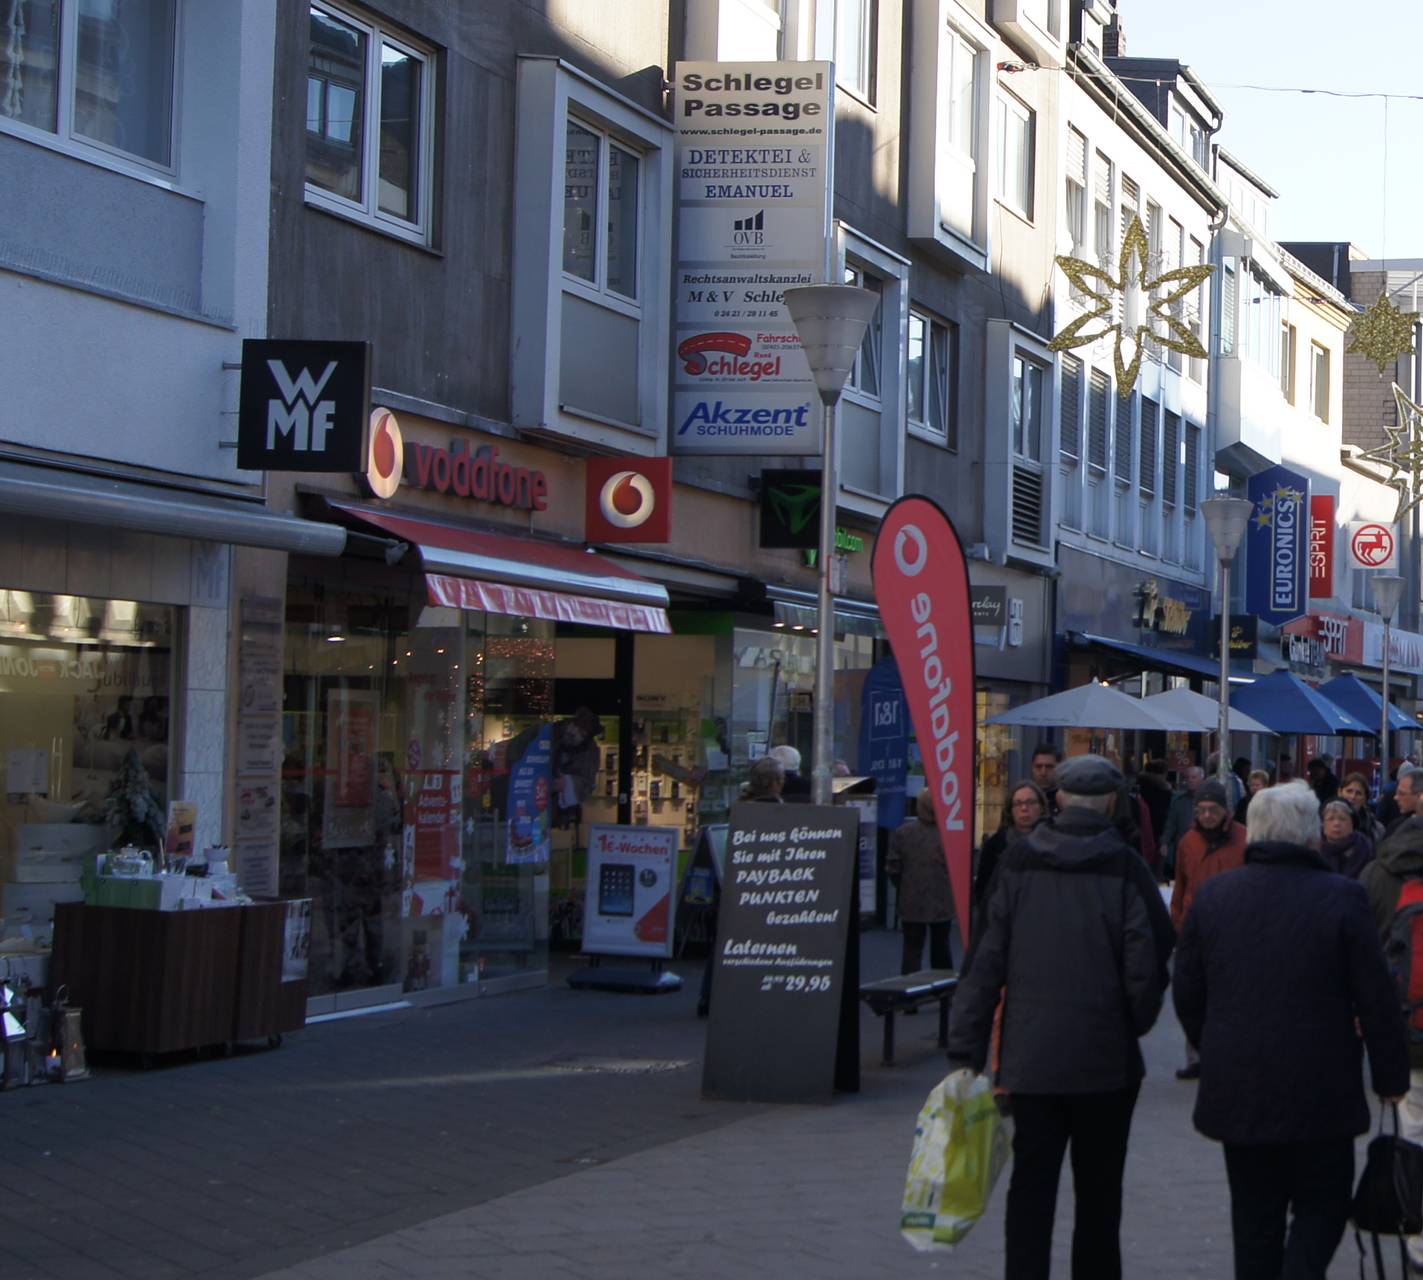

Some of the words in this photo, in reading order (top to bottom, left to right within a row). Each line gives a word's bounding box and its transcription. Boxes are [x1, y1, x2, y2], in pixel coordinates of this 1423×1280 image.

[683, 73, 823, 95] Schlegel
[684, 99, 821, 120] Passage
[680, 127, 822, 136] www.schlegel-passage.de
[688, 149, 792, 164] DETEKTEI
[798, 148, 811, 163] &
[682, 167, 816, 179] SICHERHEITSDIENST
[705, 184, 793, 198] EMANUEL
[733, 231, 764, 245] OVB
[683, 273, 812, 284] Rechtsanwaltskanzlei
[688, 291, 703, 303] M
[706, 291, 718, 303] &
[723, 291, 734, 303] V
[678, 401, 808, 435] Akzent
[697, 425, 794, 436] SCHUHMODE
[411, 438, 548, 511] vodafone
[1275, 497, 1296, 604] EURONICS
[1310, 516, 1327, 578] ESPRIT
[732, 829, 757, 845] Bei
[760, 830, 786, 843] uns
[789, 826, 842, 843] können
[732, 850, 754, 864] Sie
[757, 848, 781, 863] mit
[784, 847, 826, 861] Ihren
[735, 867, 815, 885] PAYBACK
[739, 889, 820, 905] PUNKTEN
[766, 909, 839, 925] bezahlen!
[723, 938, 798, 956] Laternen
[785, 974, 832, 992] 29,95
